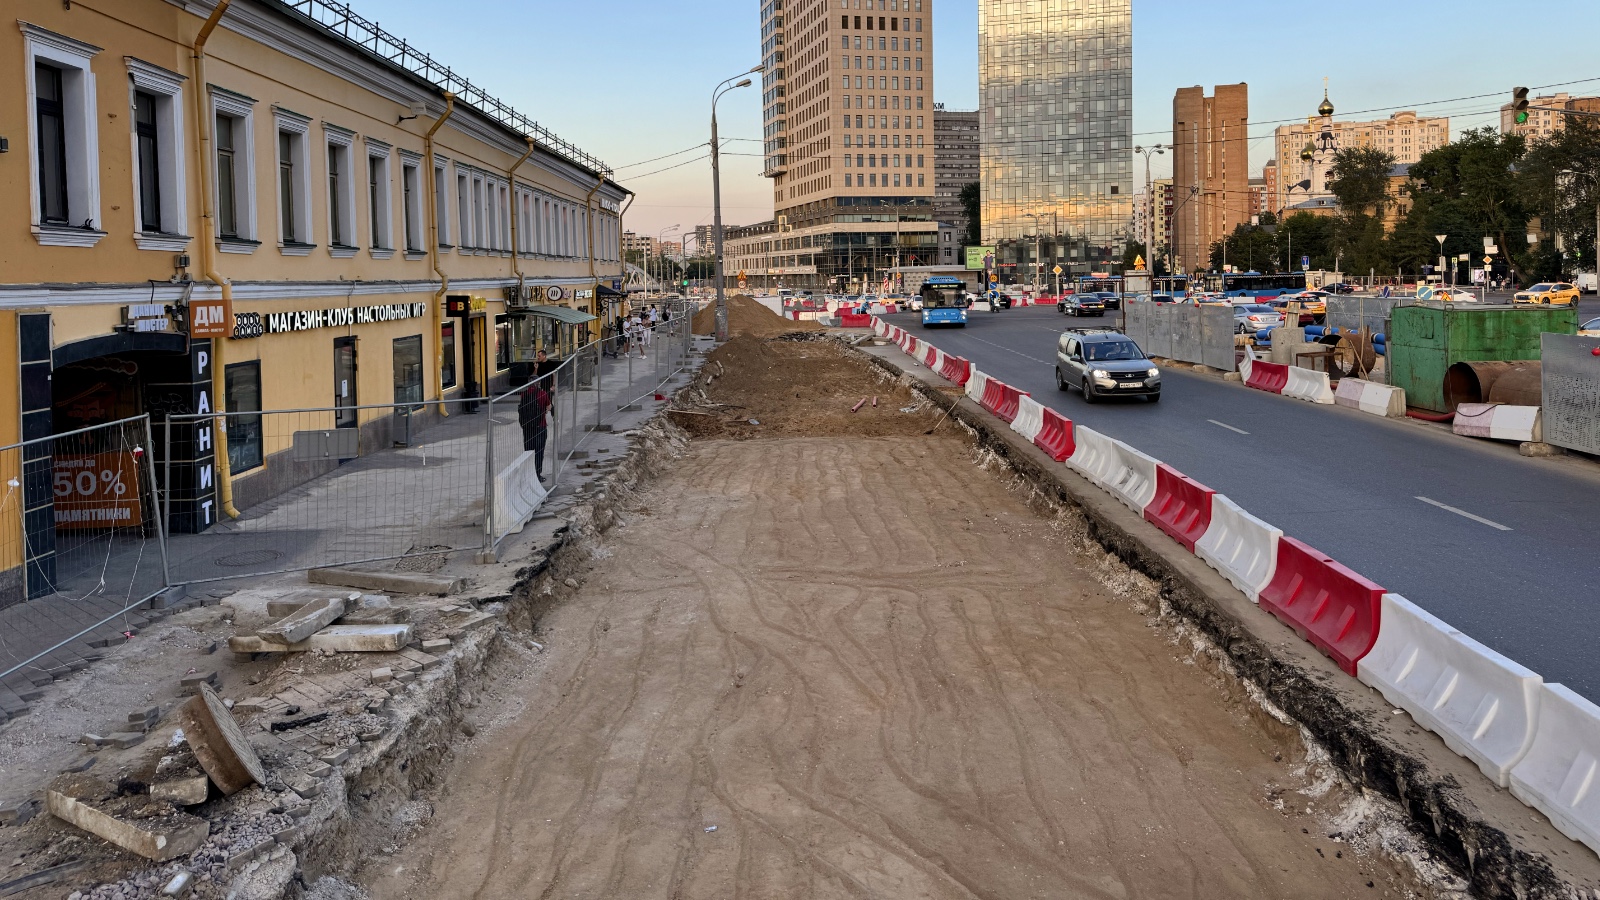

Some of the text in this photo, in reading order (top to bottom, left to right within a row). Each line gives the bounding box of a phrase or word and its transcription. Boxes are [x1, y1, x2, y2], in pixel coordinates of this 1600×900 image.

[194, 305, 225, 327] ДМ
[269, 302, 427, 334] МАГАЗИН-КЛУБ НАСТОЛЬНЫХ ИГР
[234, 325, 263, 336] GAMES
[198, 351, 213, 525] РАНИТ
[54, 469, 126, 497] 50%
[54, 507, 131, 522] ПАМЯТНИКИ
